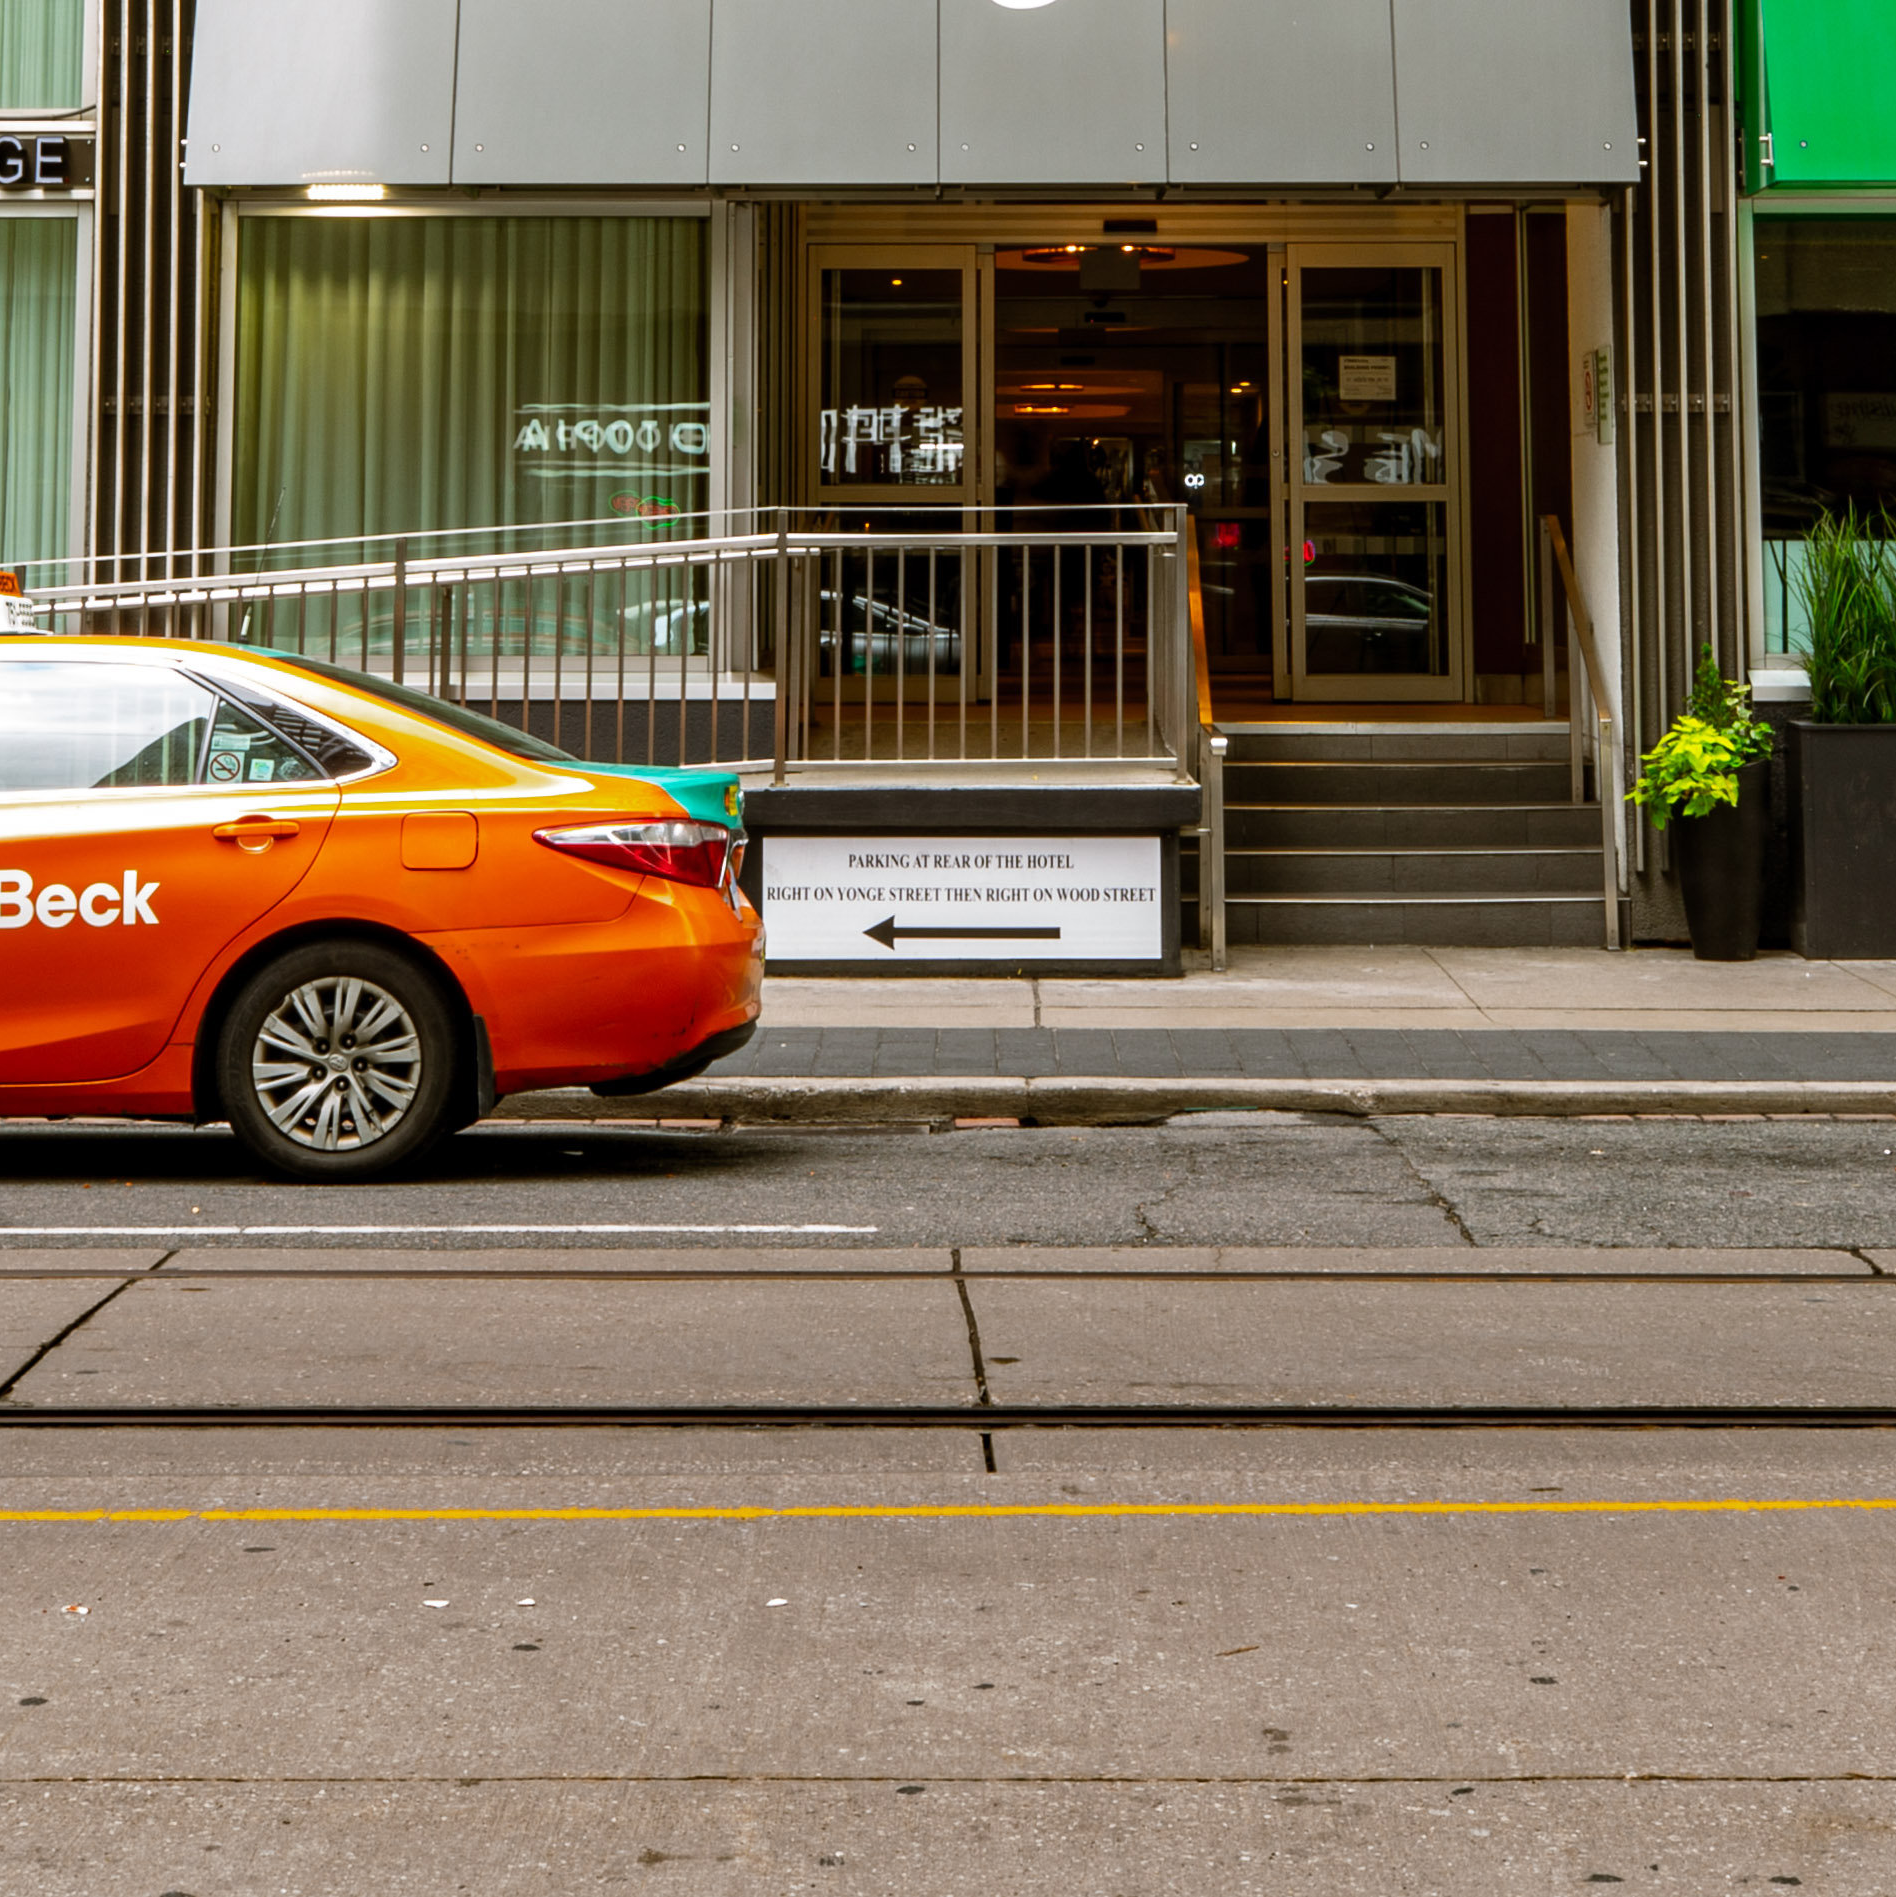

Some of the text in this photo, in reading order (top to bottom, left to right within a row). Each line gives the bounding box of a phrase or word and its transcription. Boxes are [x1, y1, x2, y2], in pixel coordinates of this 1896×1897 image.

[848, 853, 1075, 870] PARKING AT REAR OF THE HOTEL
[766, 886, 1157, 903] RIGHT ON YONGE STREET THEN RIGHT ON WOOD STREET
